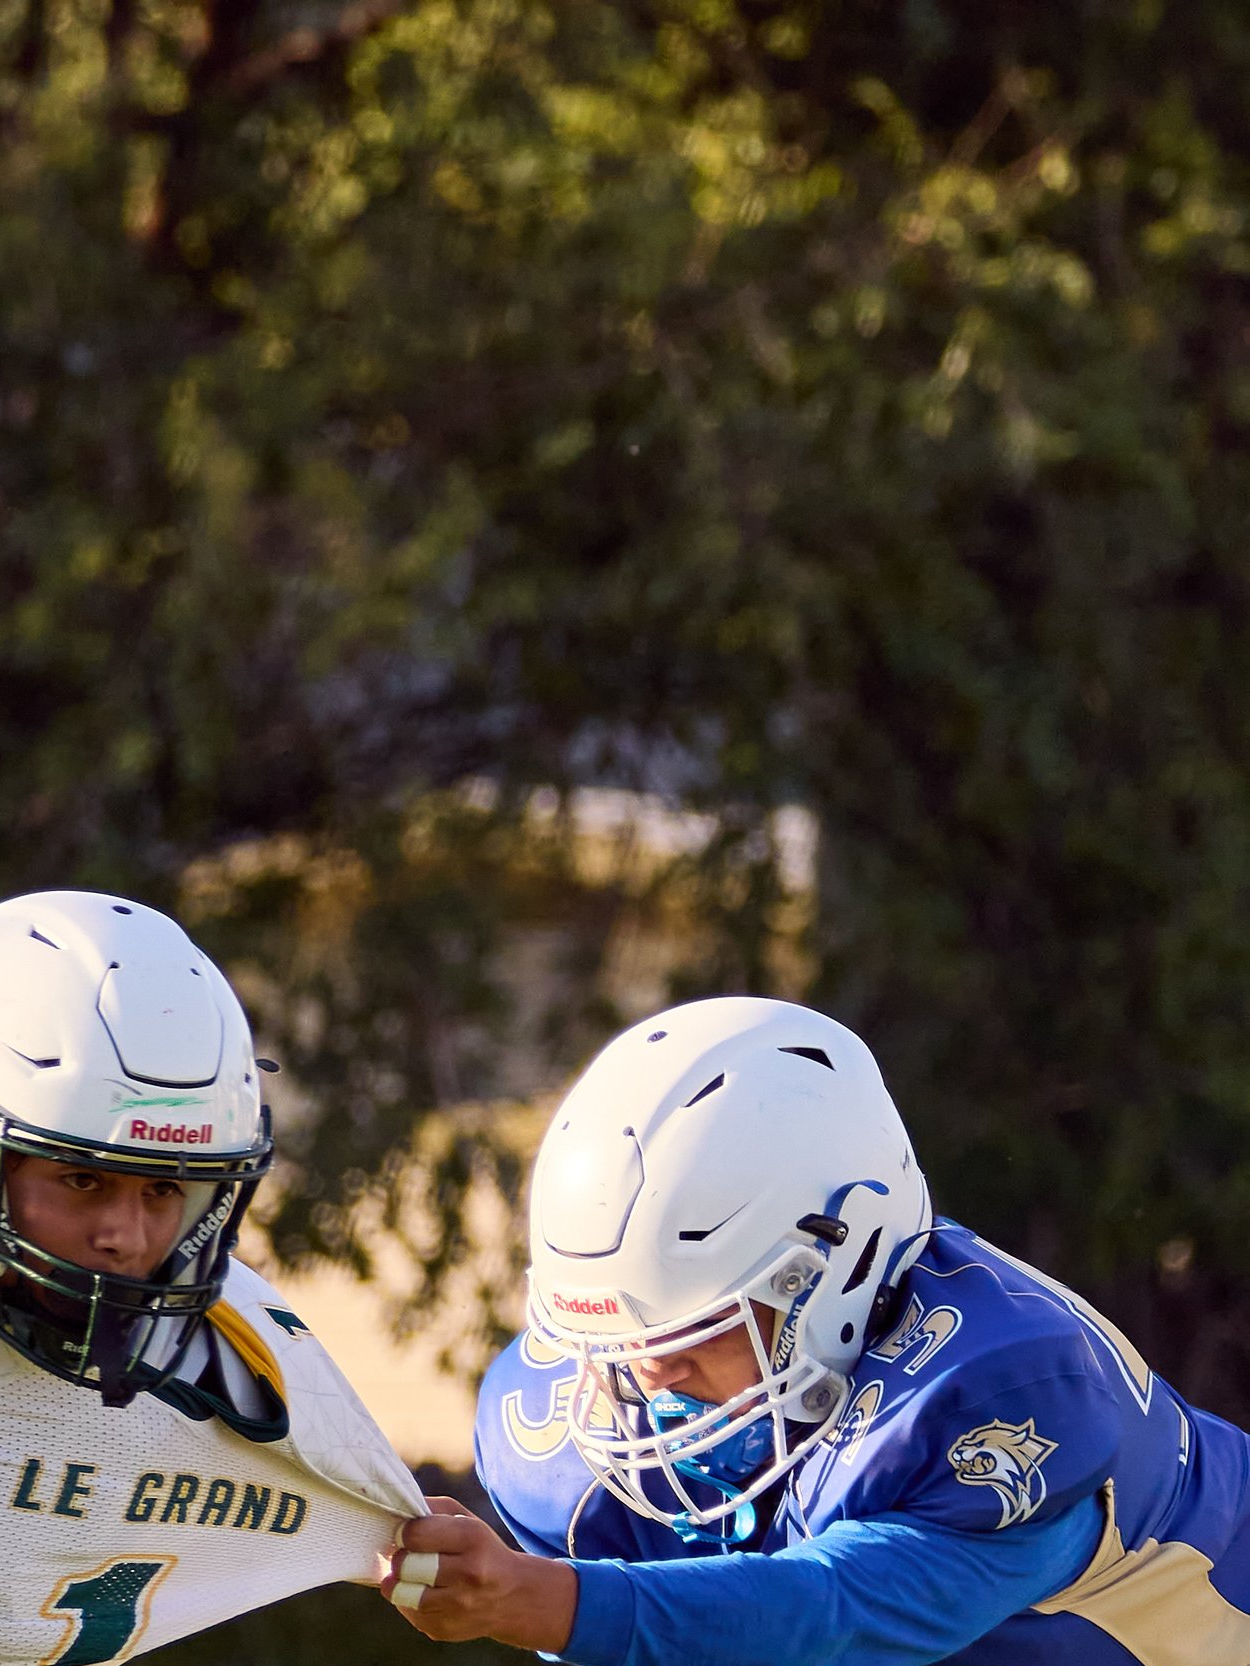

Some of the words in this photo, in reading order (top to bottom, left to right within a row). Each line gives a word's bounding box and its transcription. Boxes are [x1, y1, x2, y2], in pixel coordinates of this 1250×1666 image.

[130, 1119, 213, 1144] Riddell
[178, 1191, 233, 1260] Riddell
[9, 1454, 99, 1519] LE
[122, 1468, 310, 1537] GRAND
